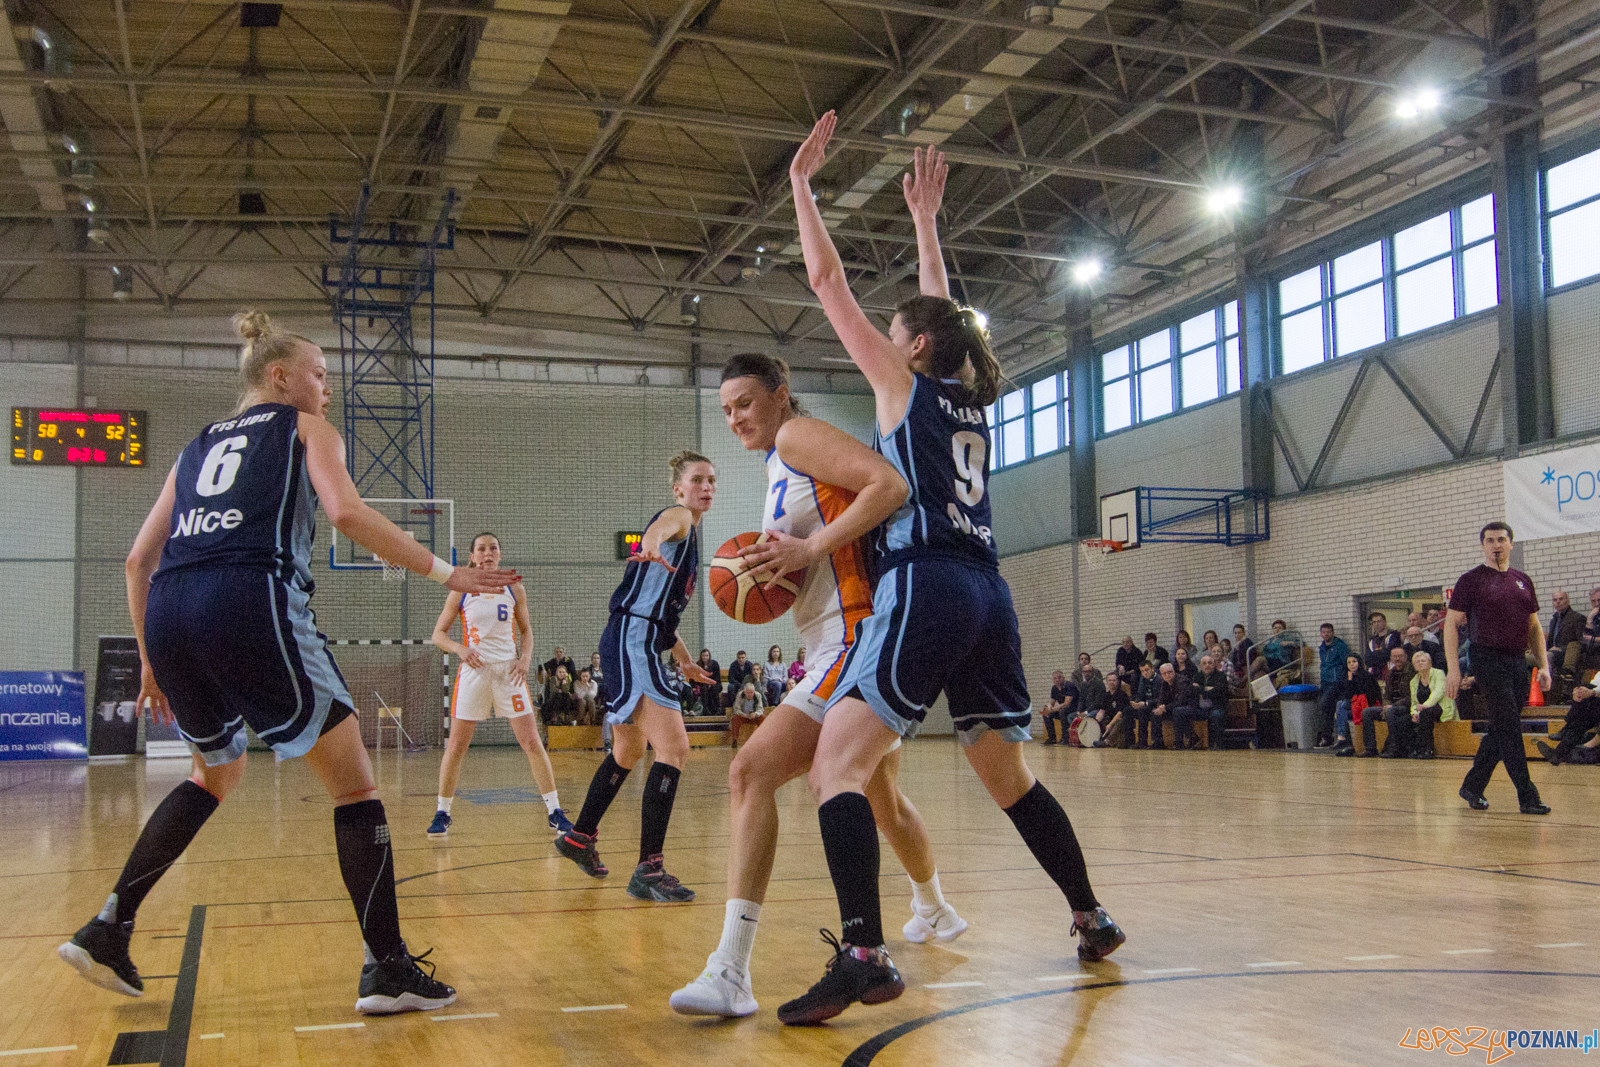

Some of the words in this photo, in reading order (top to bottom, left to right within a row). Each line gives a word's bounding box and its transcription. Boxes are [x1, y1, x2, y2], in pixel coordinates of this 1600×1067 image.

[38, 424, 58, 438] 58
[76, 428, 85, 438] 4
[106, 425, 125, 440] 52
[208, 420, 238, 434] PTS
[196, 435, 248, 497] 6
[952, 430, 986, 507] 9
[771, 478, 788, 521] 7
[1557, 471, 1600, 513] po
[171, 507, 243, 538] Nice
[947, 502, 992, 545] Nie
[497, 603, 508, 621] 6
[511, 694, 525, 713] 6
